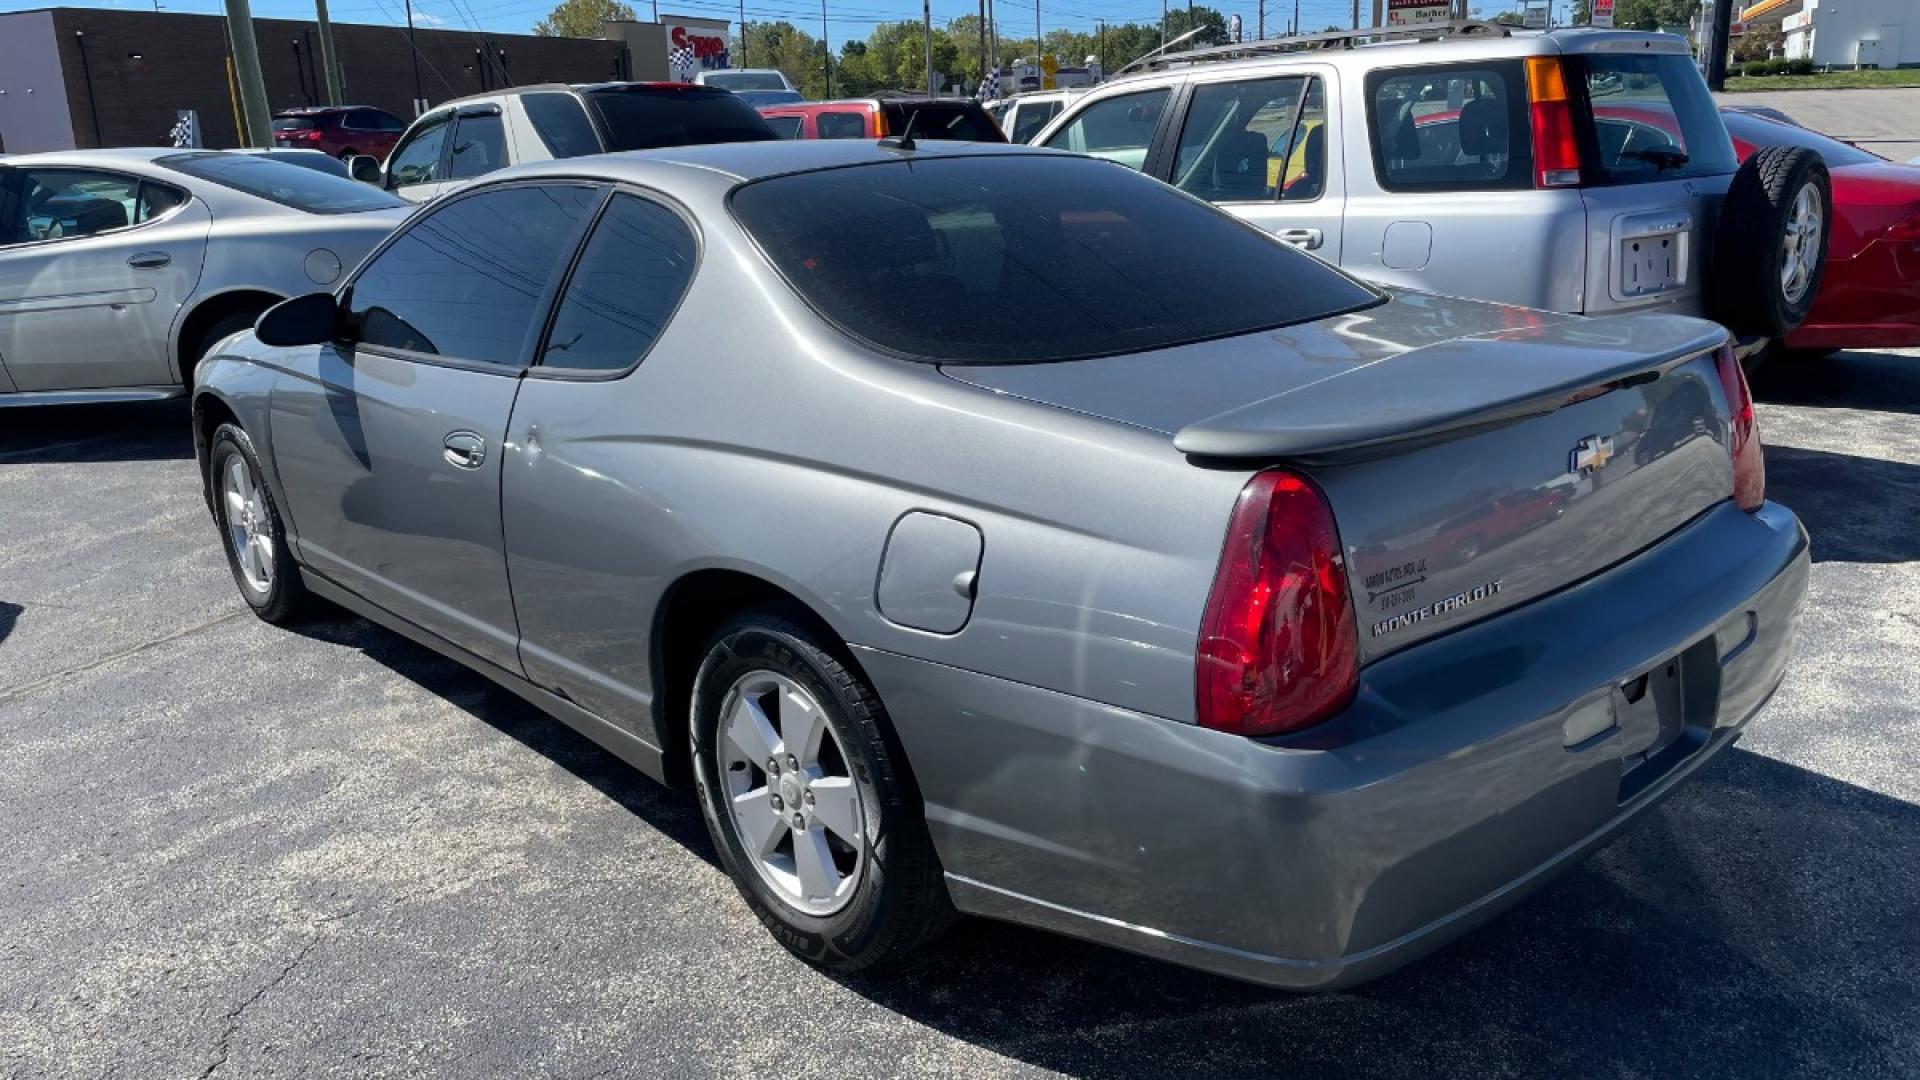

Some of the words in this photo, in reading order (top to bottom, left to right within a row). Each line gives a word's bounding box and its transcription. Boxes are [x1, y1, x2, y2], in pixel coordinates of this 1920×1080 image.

[1415, 9, 1447, 18] Barber
[671, 26, 724, 58] Save
[1372, 606, 1430, 638] MONTE
[1432, 587, 1485, 617] CARLO
[1486, 580, 1503, 597] LT
